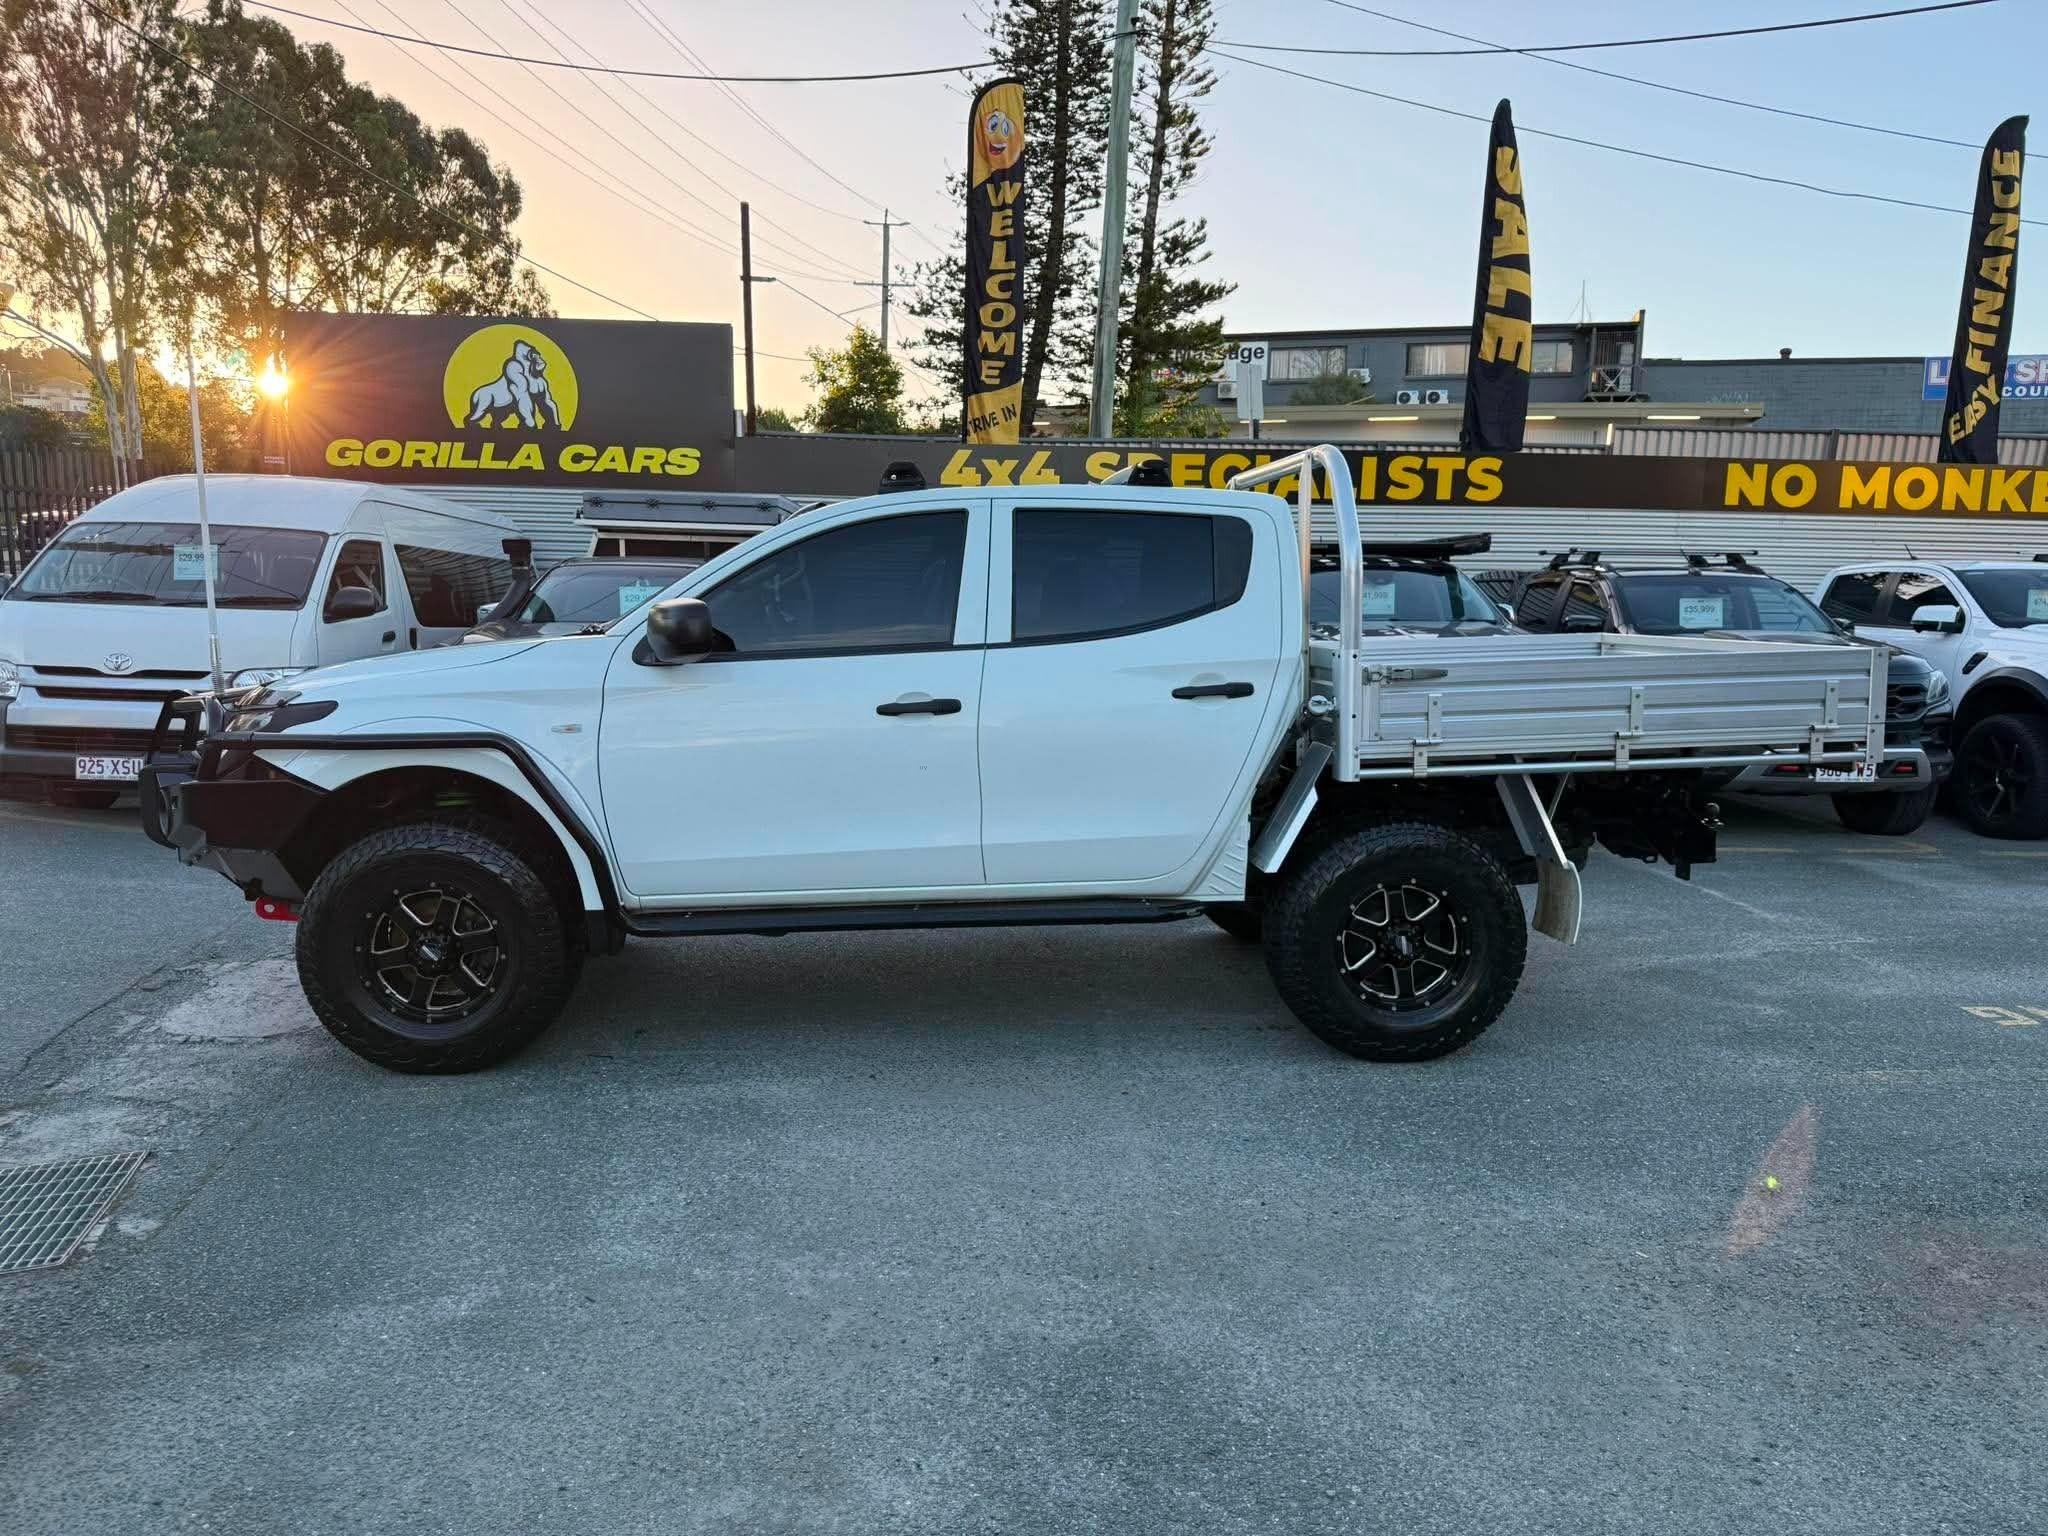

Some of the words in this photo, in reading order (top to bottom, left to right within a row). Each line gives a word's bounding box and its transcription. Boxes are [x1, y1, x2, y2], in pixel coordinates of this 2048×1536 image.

[978, 181, 1022, 385] WELCOME
[1477, 146, 1532, 374] SALE
[1965, 148, 2021, 375] FINANCE
[1001, 403, 1017, 423] IN
[1951, 374, 2001, 445] EASY
[325, 438, 545, 471] GORILLA
[558, 443, 701, 475] CARS
[940, 449, 1060, 487] 4x4
[1724, 463, 1817, 508] NO
